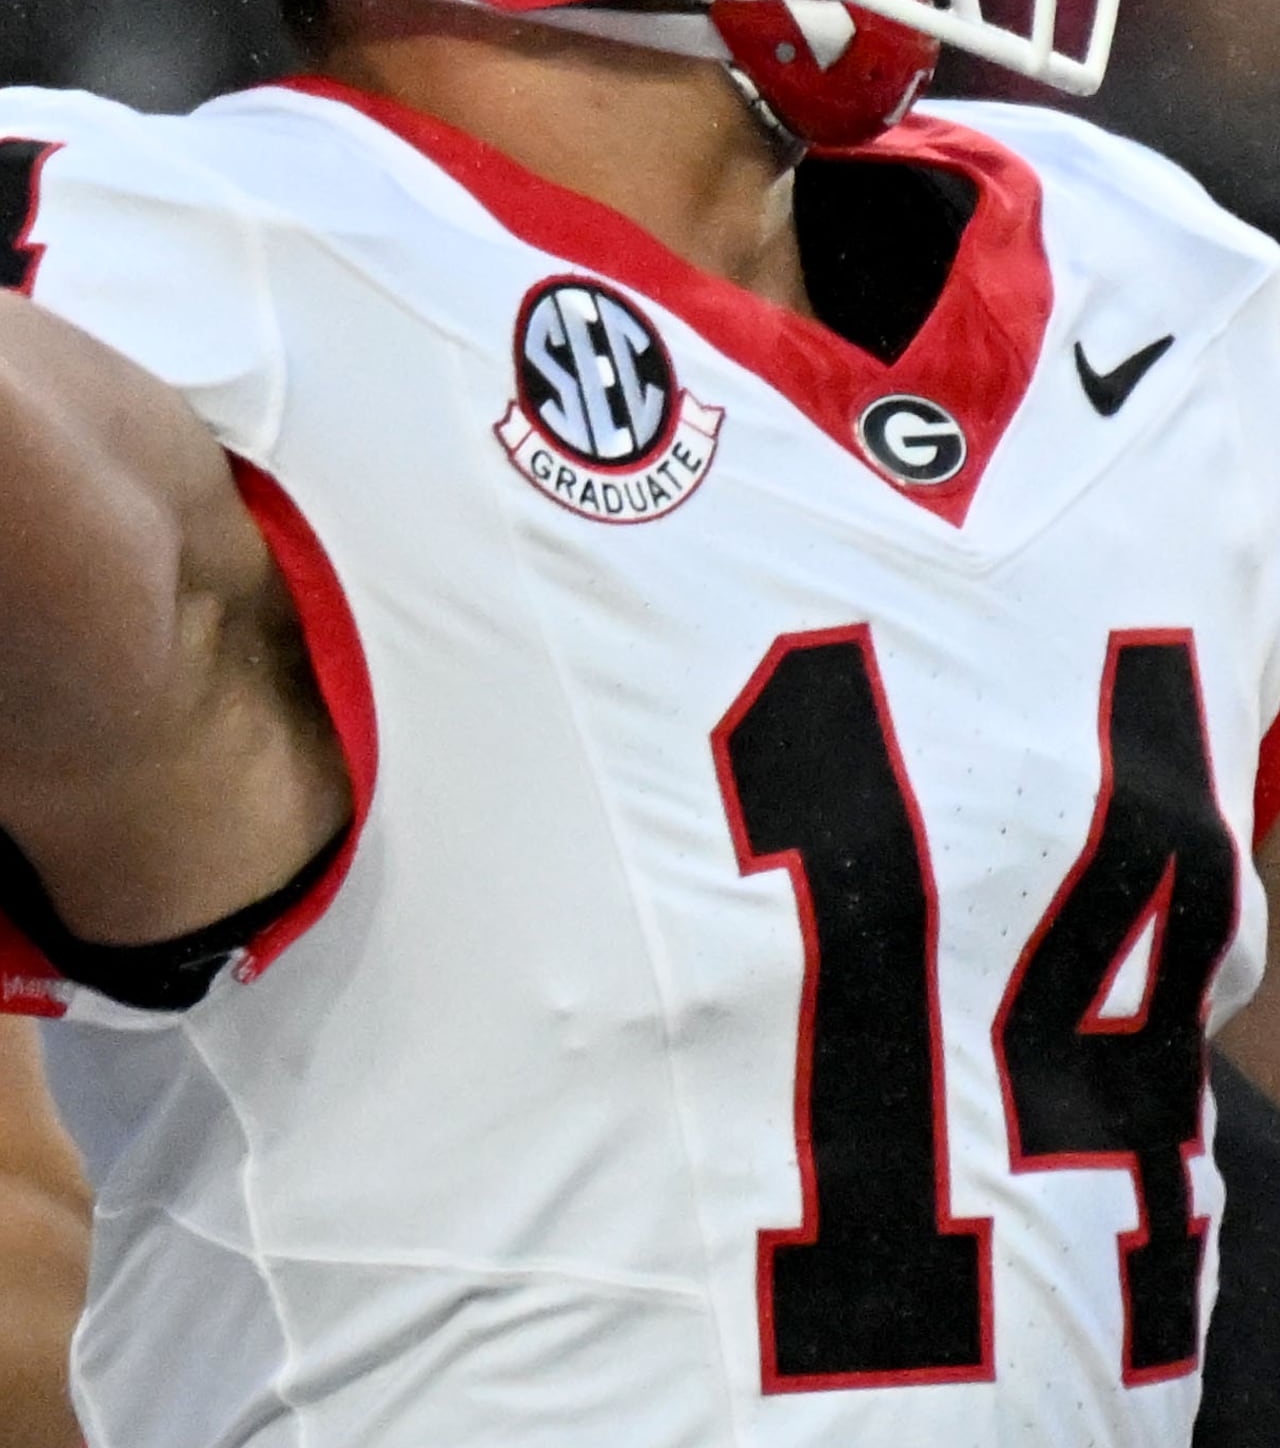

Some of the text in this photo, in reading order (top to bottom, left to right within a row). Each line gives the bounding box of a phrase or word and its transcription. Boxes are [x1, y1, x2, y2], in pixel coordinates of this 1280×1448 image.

[524, 288, 664, 458] SEC
[531, 441, 702, 513] GRADUATE
[711, 623, 1241, 1394] 14
